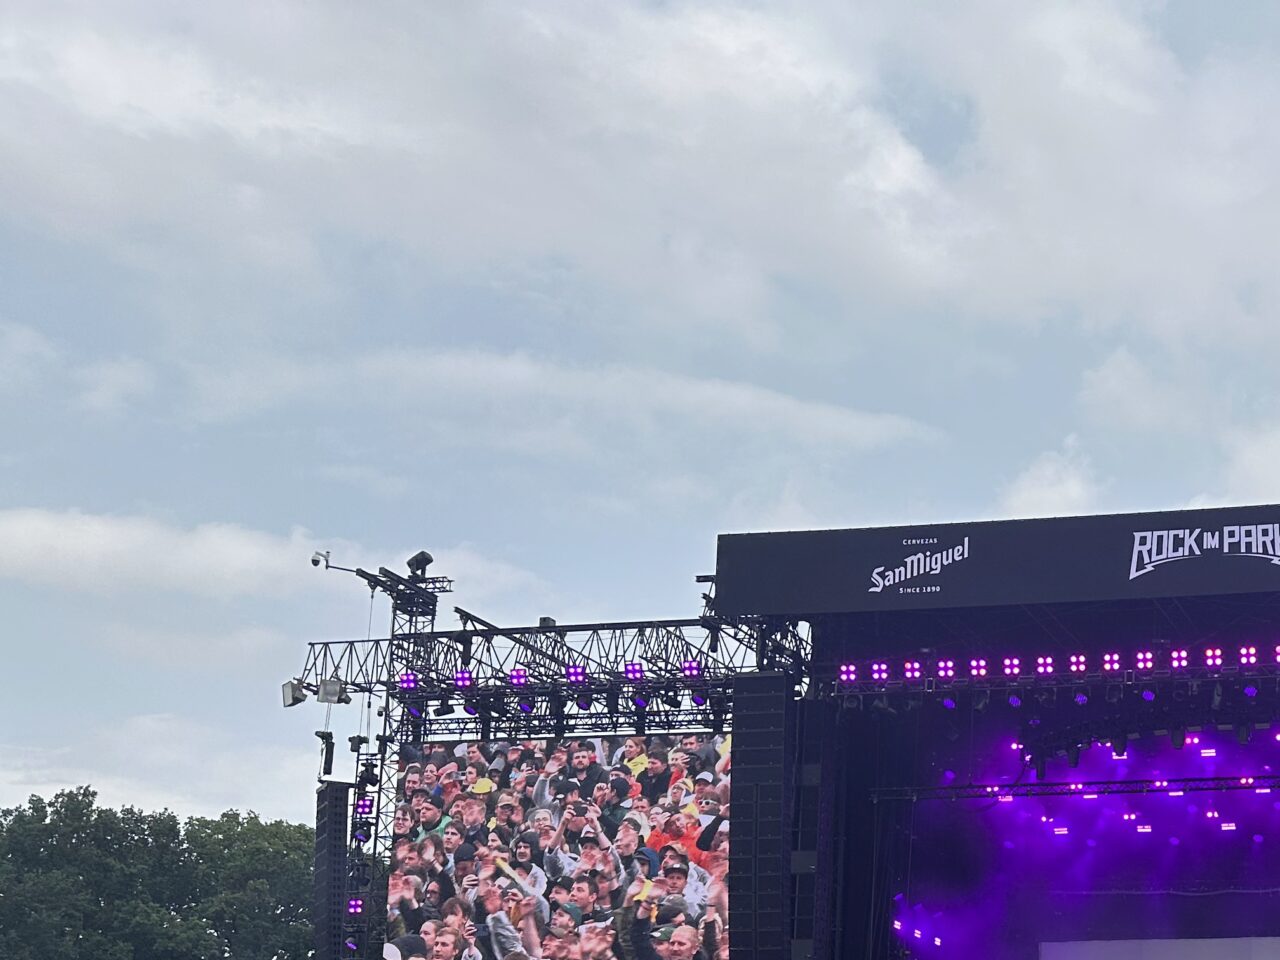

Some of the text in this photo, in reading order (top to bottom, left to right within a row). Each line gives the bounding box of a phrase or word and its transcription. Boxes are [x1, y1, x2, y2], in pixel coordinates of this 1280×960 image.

[902, 538, 938, 546] CERVEZAS
[1129, 529, 1202, 580] ROCK
[1203, 531, 1220, 550] IM
